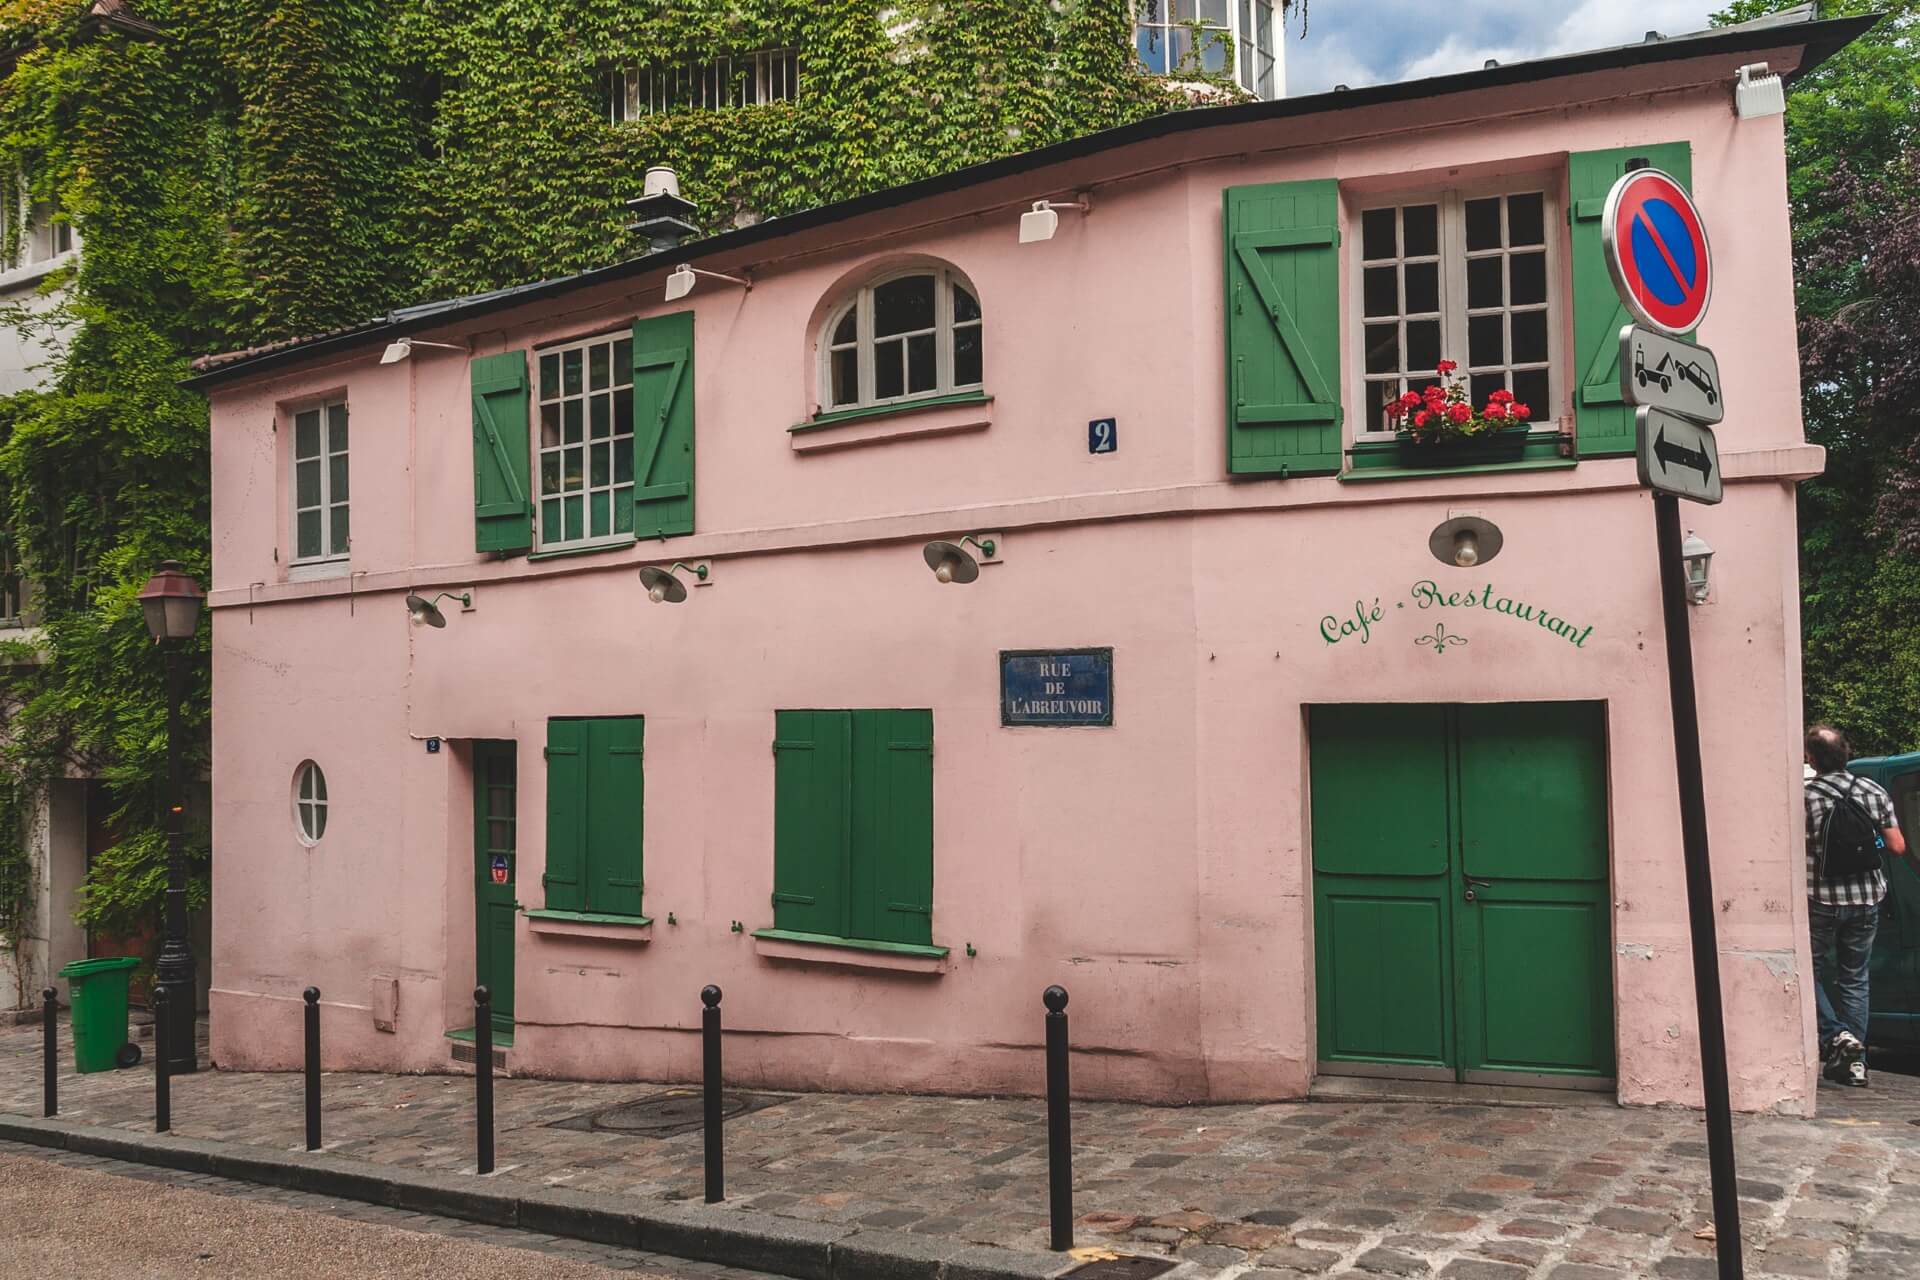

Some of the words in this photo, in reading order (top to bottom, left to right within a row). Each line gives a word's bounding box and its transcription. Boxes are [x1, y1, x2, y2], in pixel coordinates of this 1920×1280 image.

[1095, 422, 1110, 451] 2
[1319, 597, 1386, 646] Café
[1411, 580, 1593, 648] Restaurant
[1040, 663, 1071, 677] RUE
[1045, 682, 1065, 695] DE
[1011, 697, 1102, 714] L'ABREUVOIR
[429, 740, 437, 751] 2
